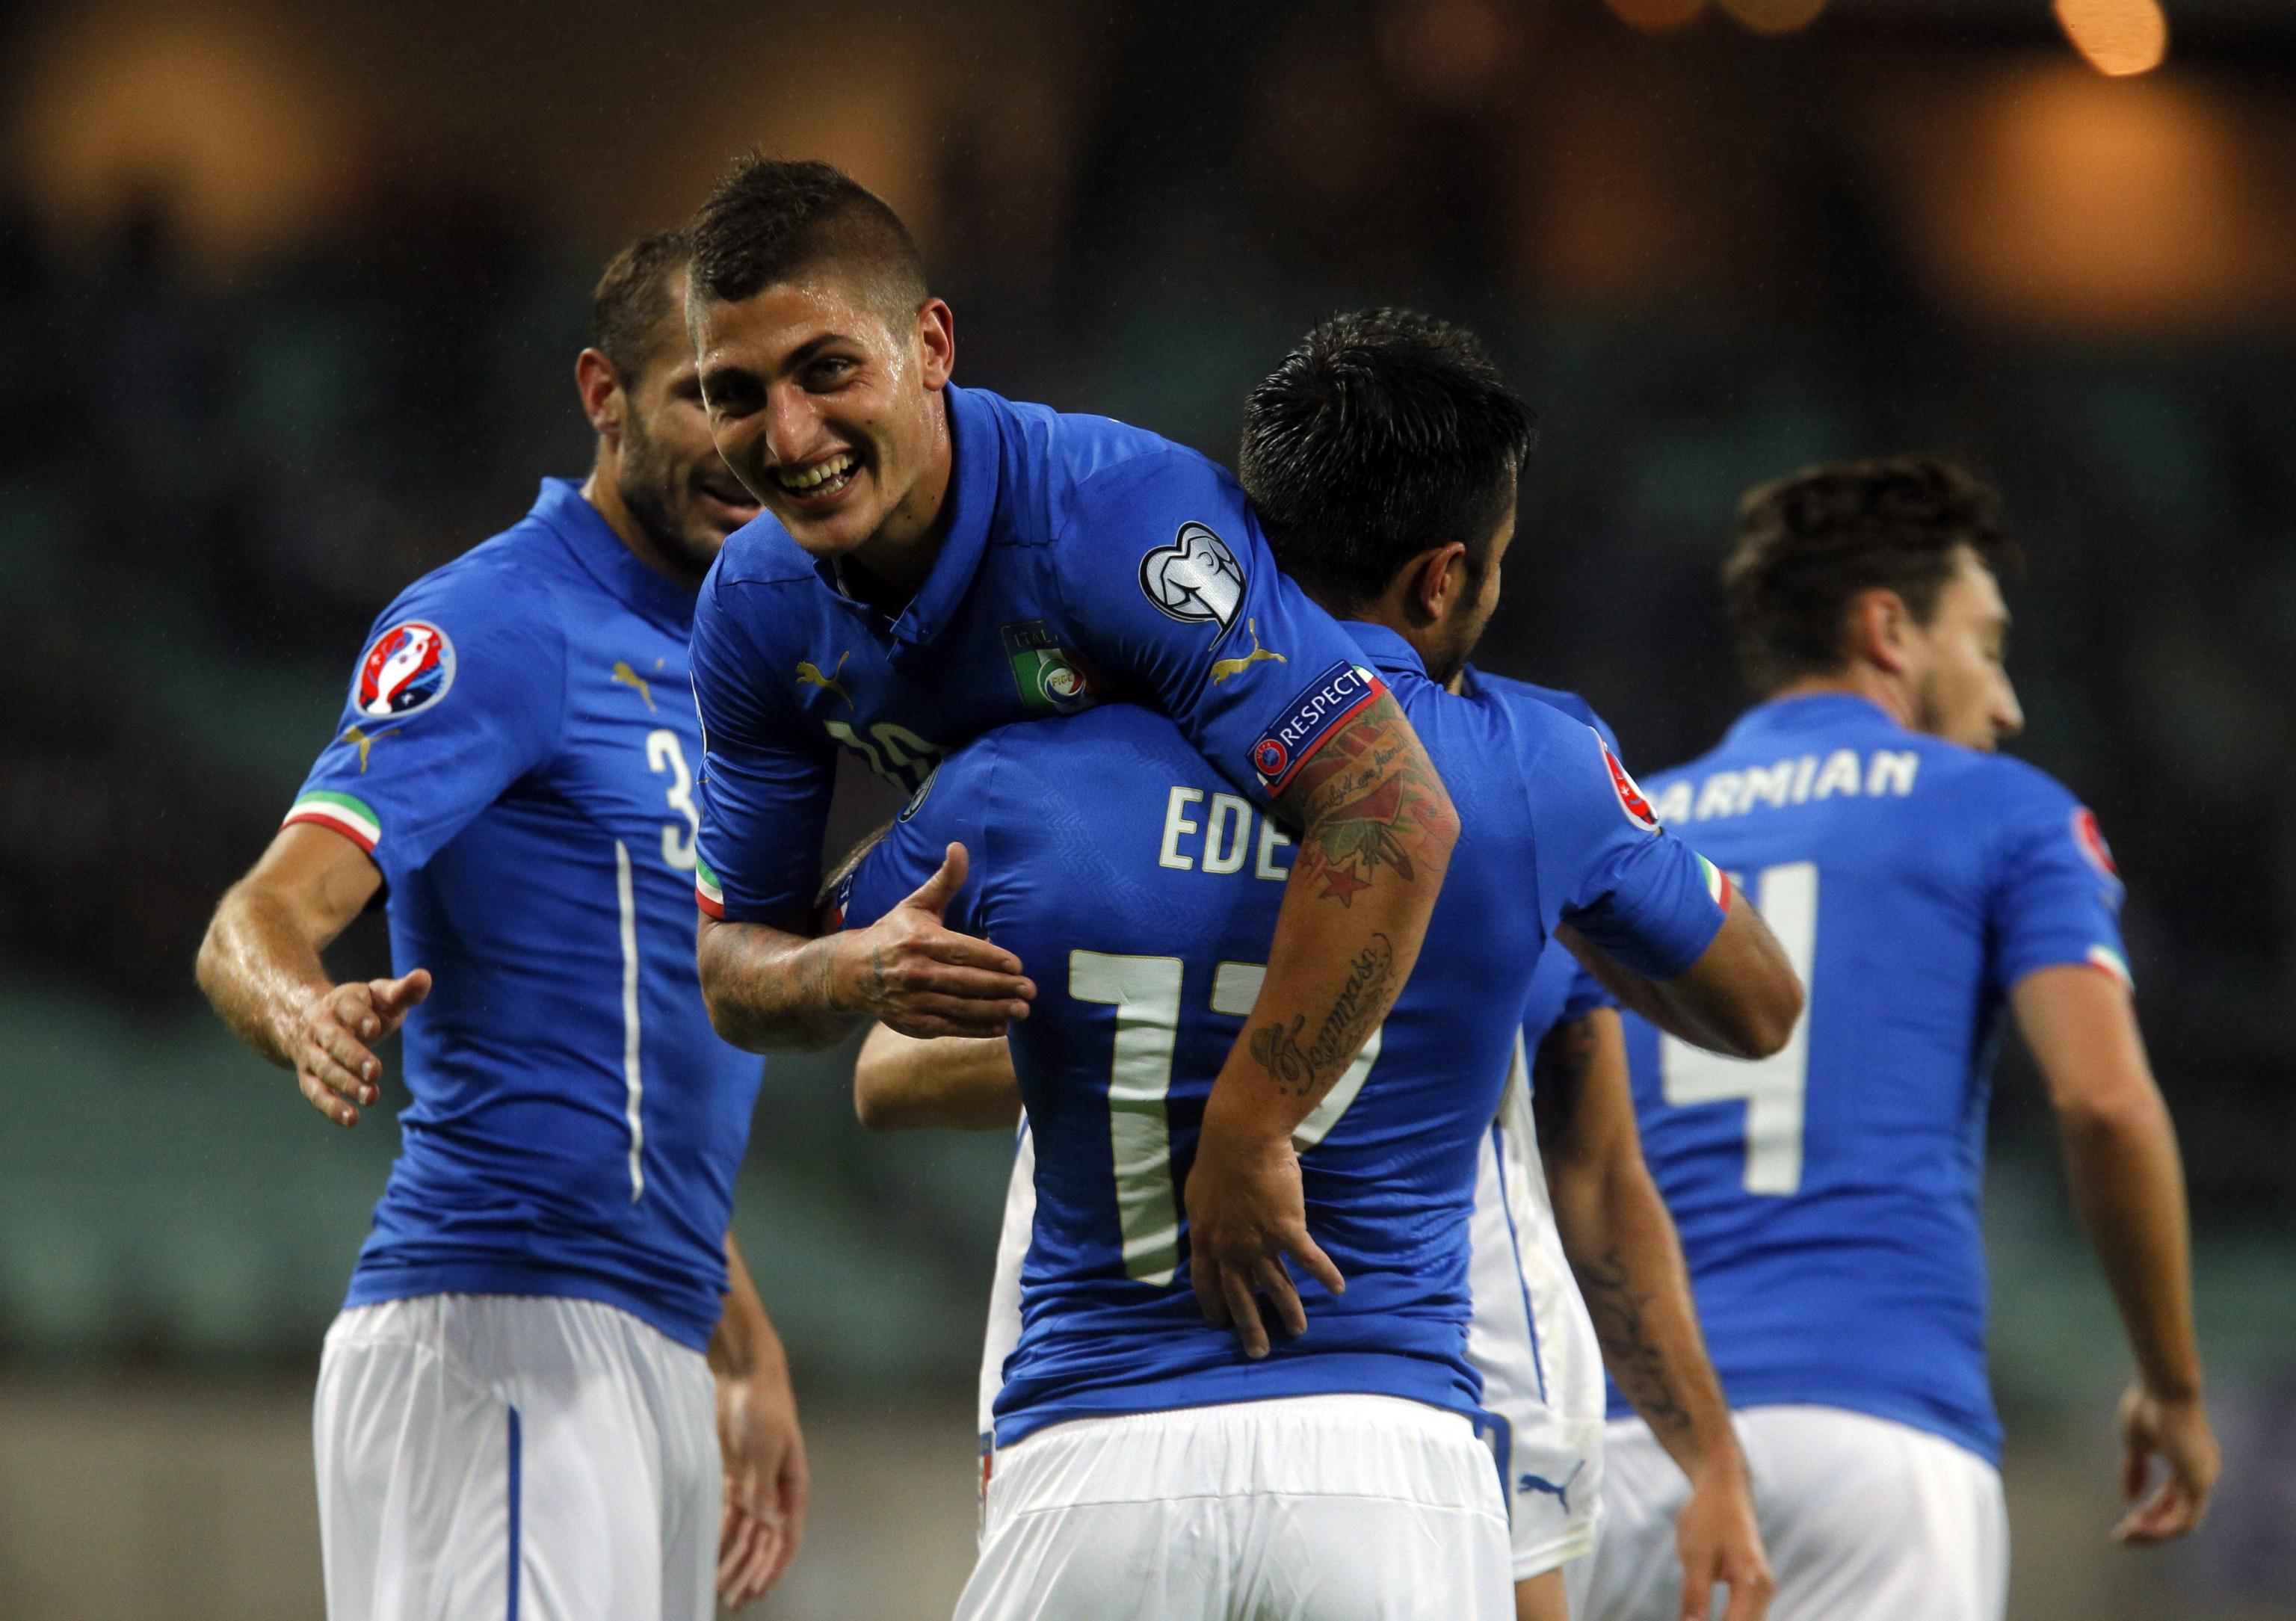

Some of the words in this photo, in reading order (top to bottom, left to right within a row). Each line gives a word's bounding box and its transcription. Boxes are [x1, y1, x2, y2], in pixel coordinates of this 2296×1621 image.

[1279, 669, 1361, 747] RESPECT
[646, 729, 700, 871] 3
[1644, 747, 1919, 825] ARMIAN
[1661, 861, 1820, 1197] 4
